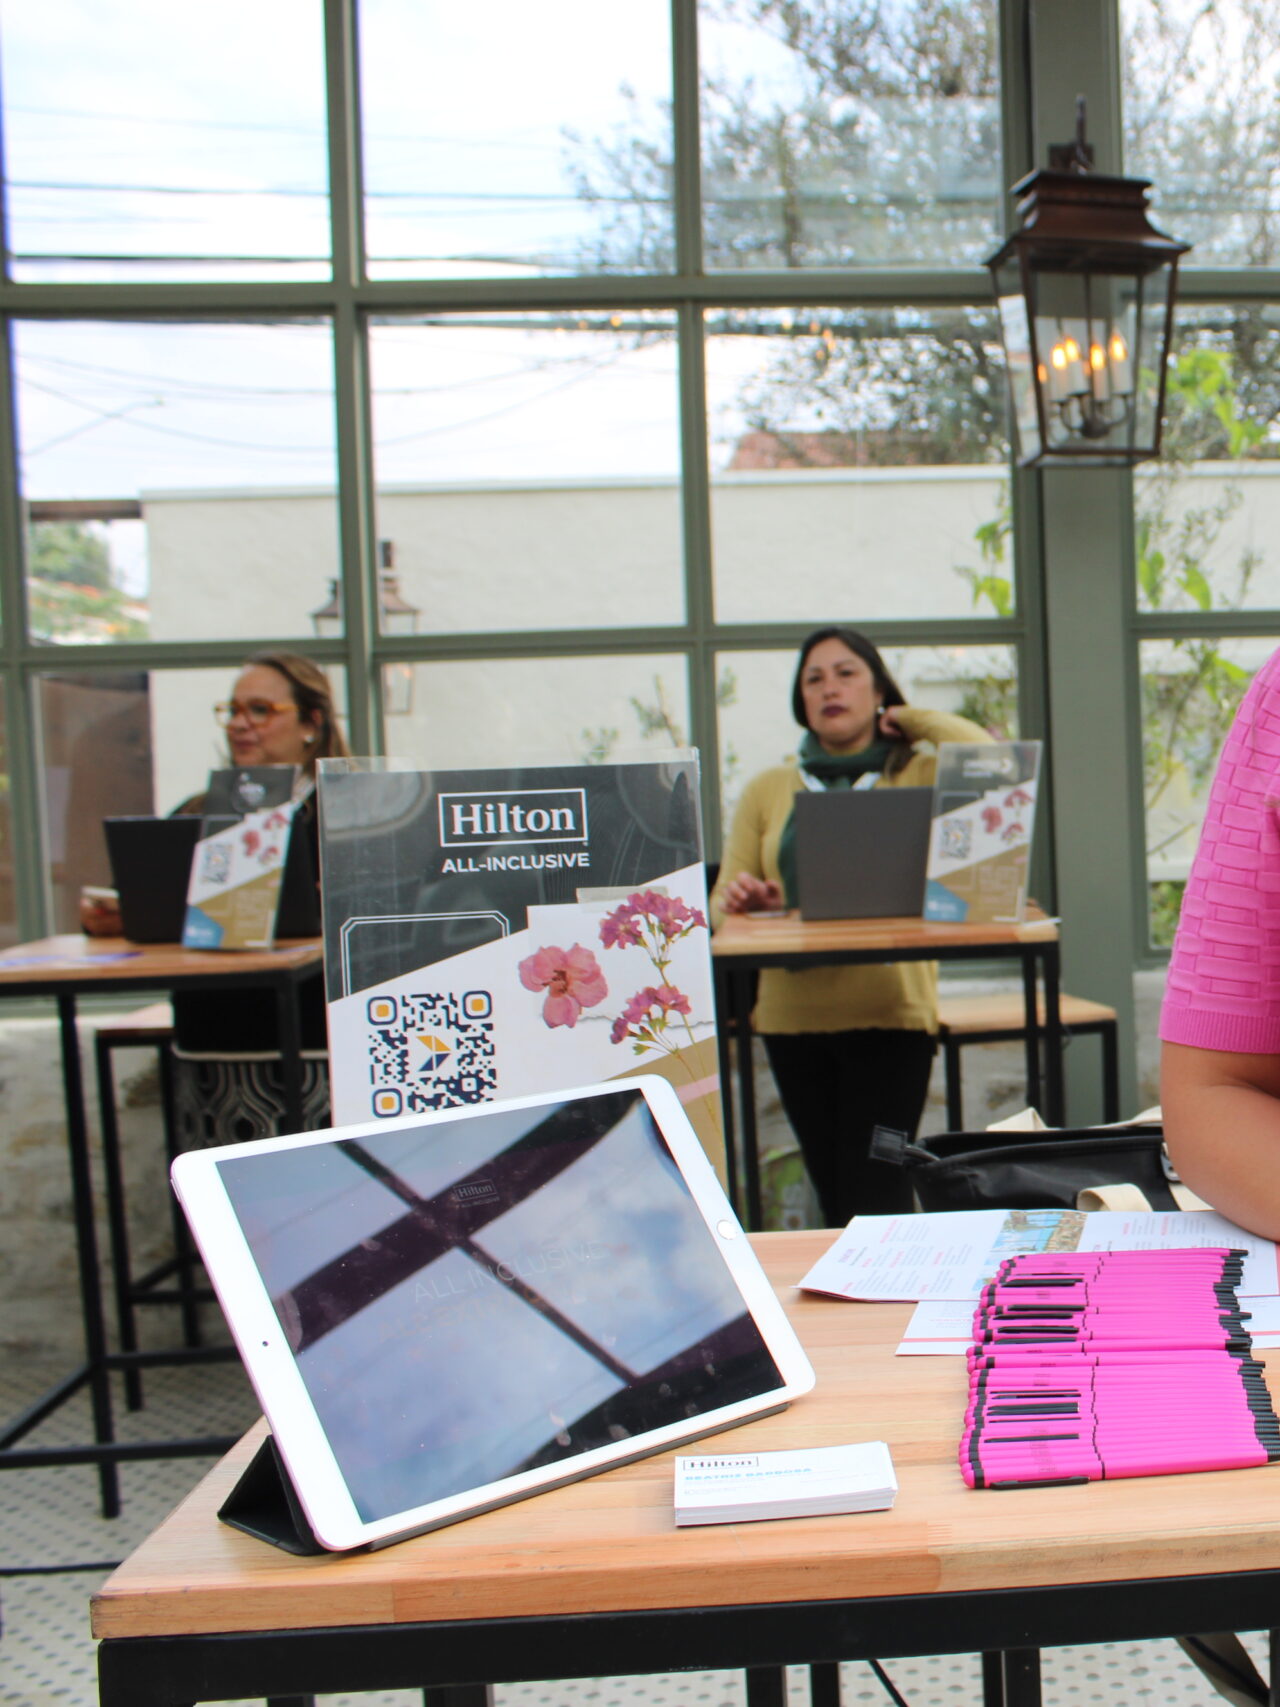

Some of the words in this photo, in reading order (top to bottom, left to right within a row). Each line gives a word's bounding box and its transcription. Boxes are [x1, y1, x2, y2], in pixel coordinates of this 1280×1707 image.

[451, 803, 575, 835] Hilton
[442, 852, 590, 874] ALL-INCLUSIVE
[457, 1184, 493, 1198] Hilton
[414, 1275, 465, 1303] ALL
[470, 1240, 606, 1289] INCLUSIVE
